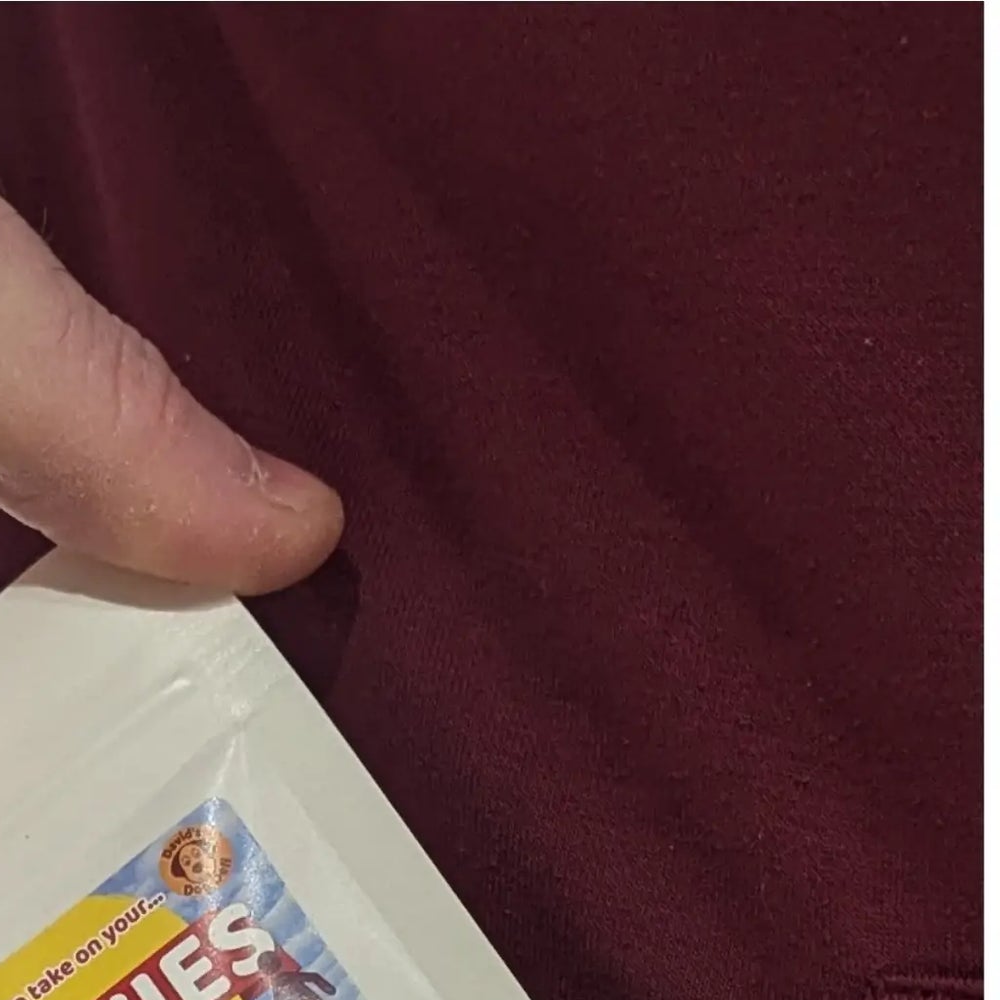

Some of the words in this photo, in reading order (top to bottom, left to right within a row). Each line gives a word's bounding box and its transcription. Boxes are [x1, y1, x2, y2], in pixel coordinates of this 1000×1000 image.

[27, 959, 75, 999] take
[75, 938, 103, 965] on
[101, 894, 165, 945] your...
